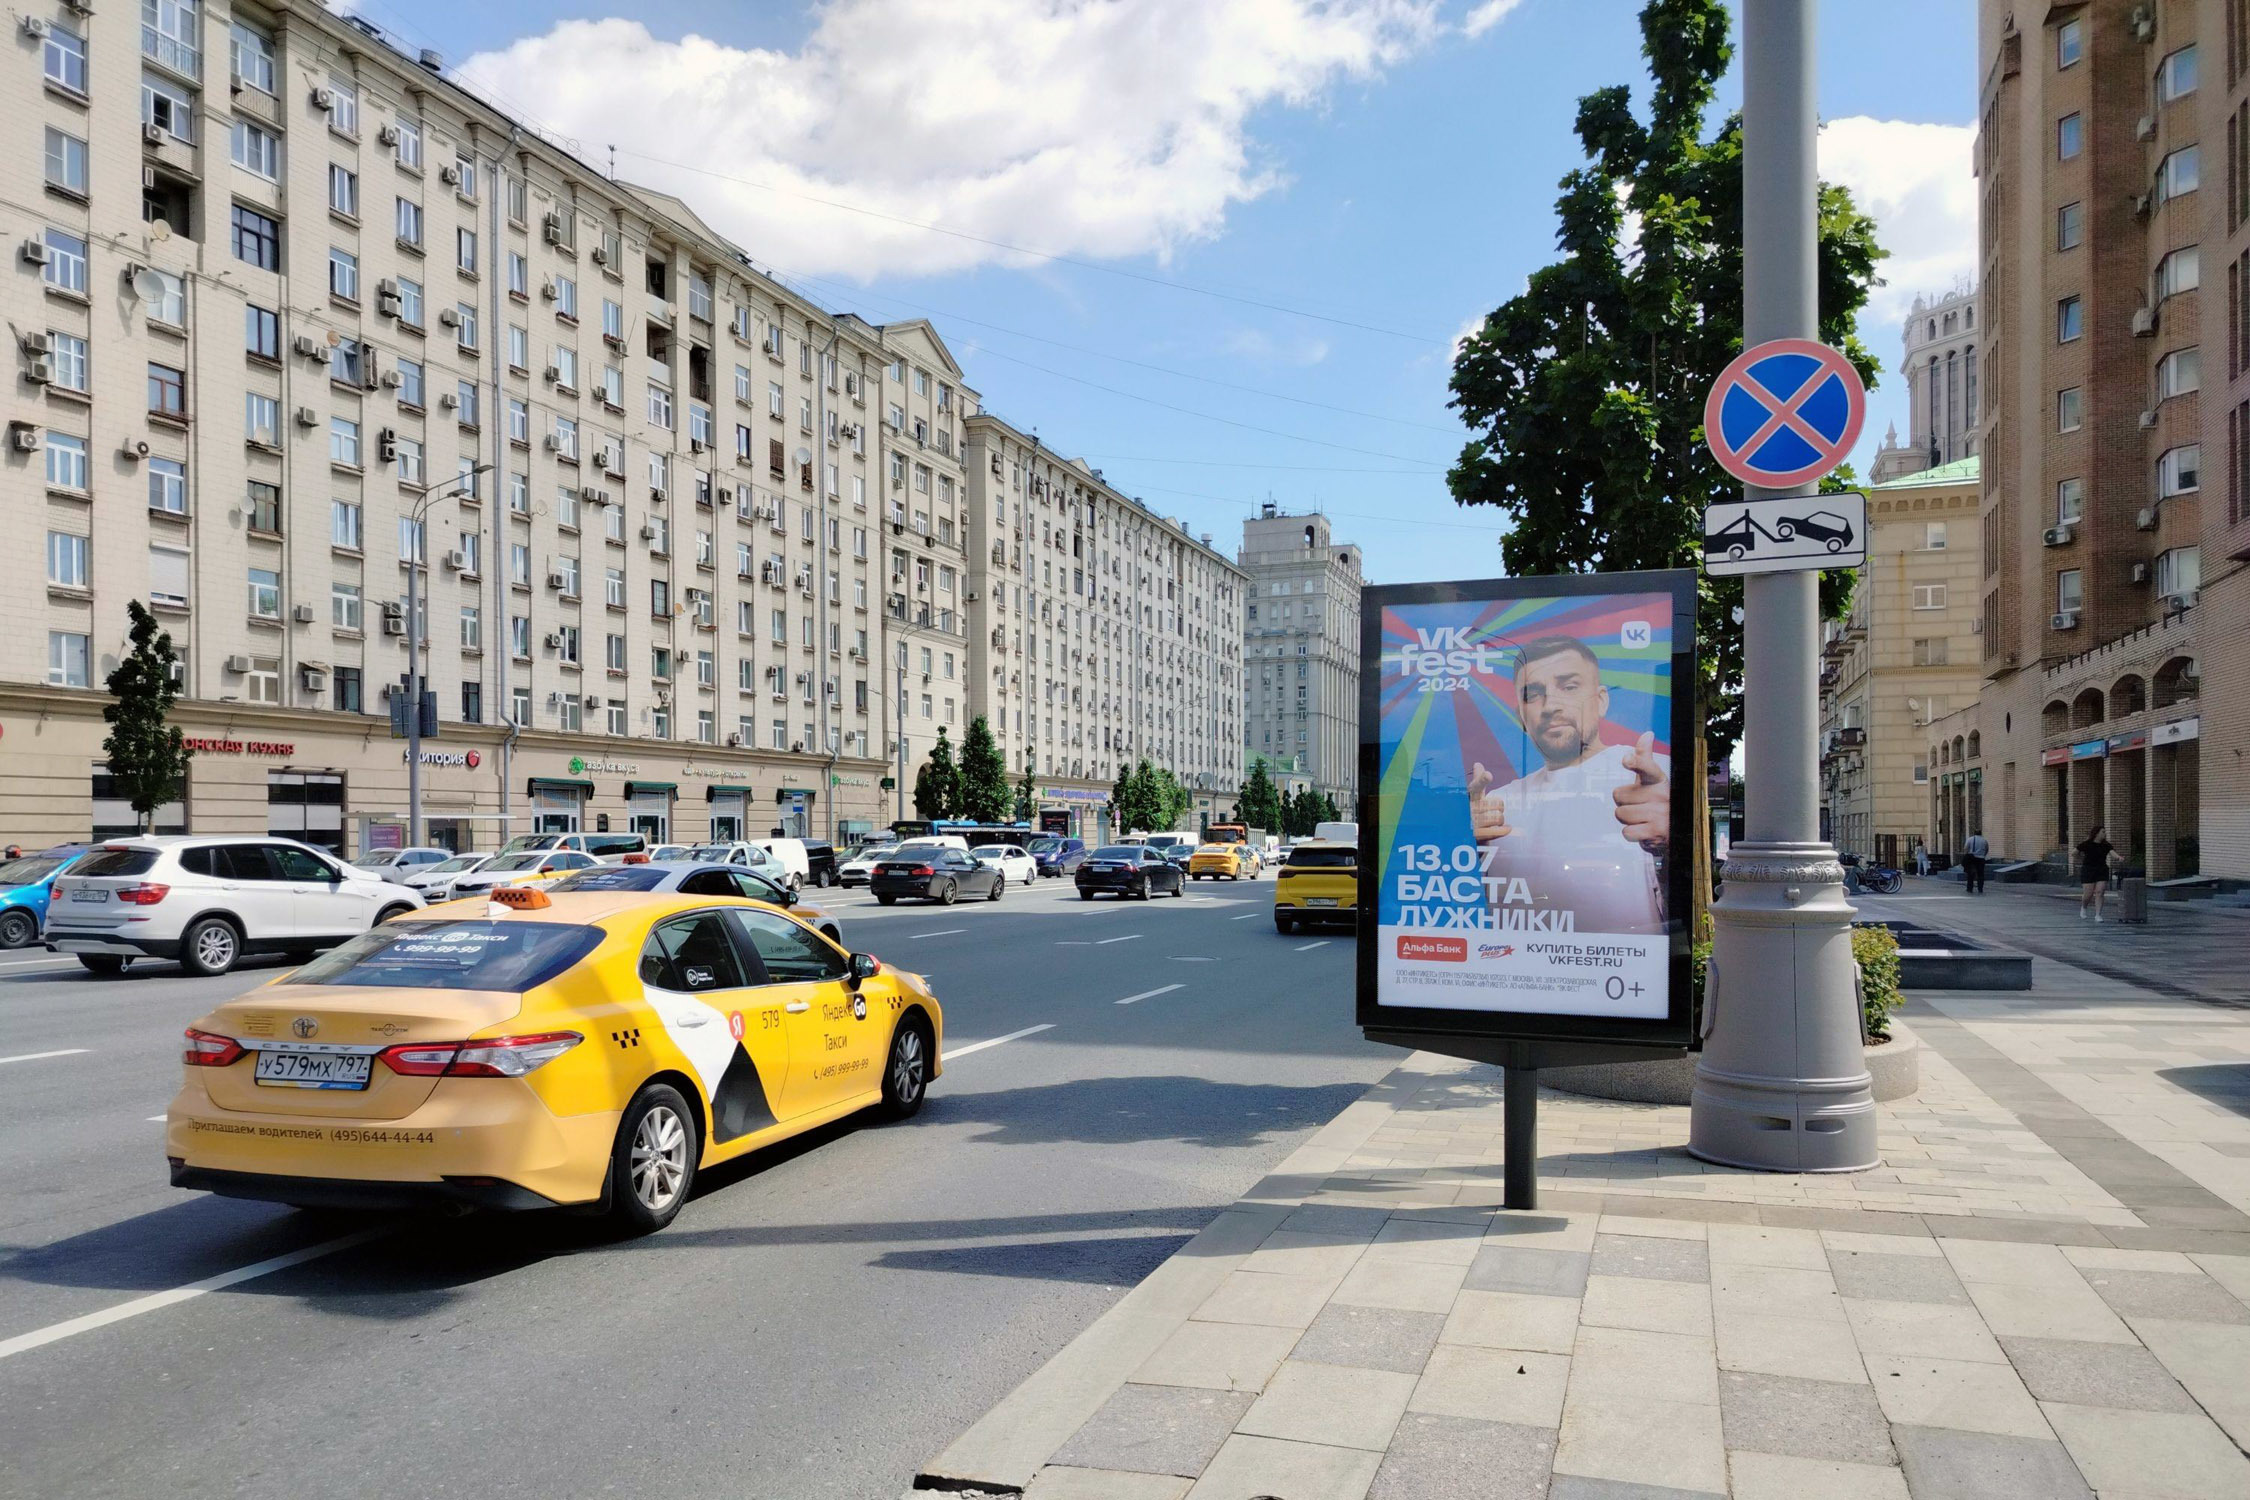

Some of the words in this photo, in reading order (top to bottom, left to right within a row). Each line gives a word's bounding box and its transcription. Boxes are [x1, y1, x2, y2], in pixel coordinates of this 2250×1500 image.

[1416, 626, 1473, 651] VK
[1626, 629, 1646, 641] VK
[1401, 643, 1504, 677] fest
[1418, 677, 1470, 692] 2024
[247, 741, 295, 755] КУХНЯ
[1398, 844, 1499, 873] 13.07
[1397, 874, 1533, 905] БАСТА
[1396, 905, 1575, 933] ЛУЖНИКИ
[469, 933, 509, 942] Такси
[403, 944, 482, 954] 999-99-99
[1403, 942, 1435, 954] Альфа
[1436, 944, 1462, 954] Банк
[1527, 943, 1583, 955] КУПИТЬ
[1586, 945, 1647, 957] БИЛЕТЫ
[1548, 955, 1624, 968] VKFEST.RU
[1605, 976, 1646, 1001] 0+
[761, 1009, 780, 1030] 579
[822, 1001, 852, 1022] Яндекс
[854, 999, 866, 1018] Go
[823, 1032, 848, 1051] Такси
[337, 1056, 366, 1073] 797
[819, 1064, 837, 1080] (495)
[837, 1057, 869, 1076] 999-99-99
[188, 1118, 256, 1136] Приглашаем
[258, 1126, 324, 1141] водителей
[330, 1129, 434, 1145] (495)644-44-44
